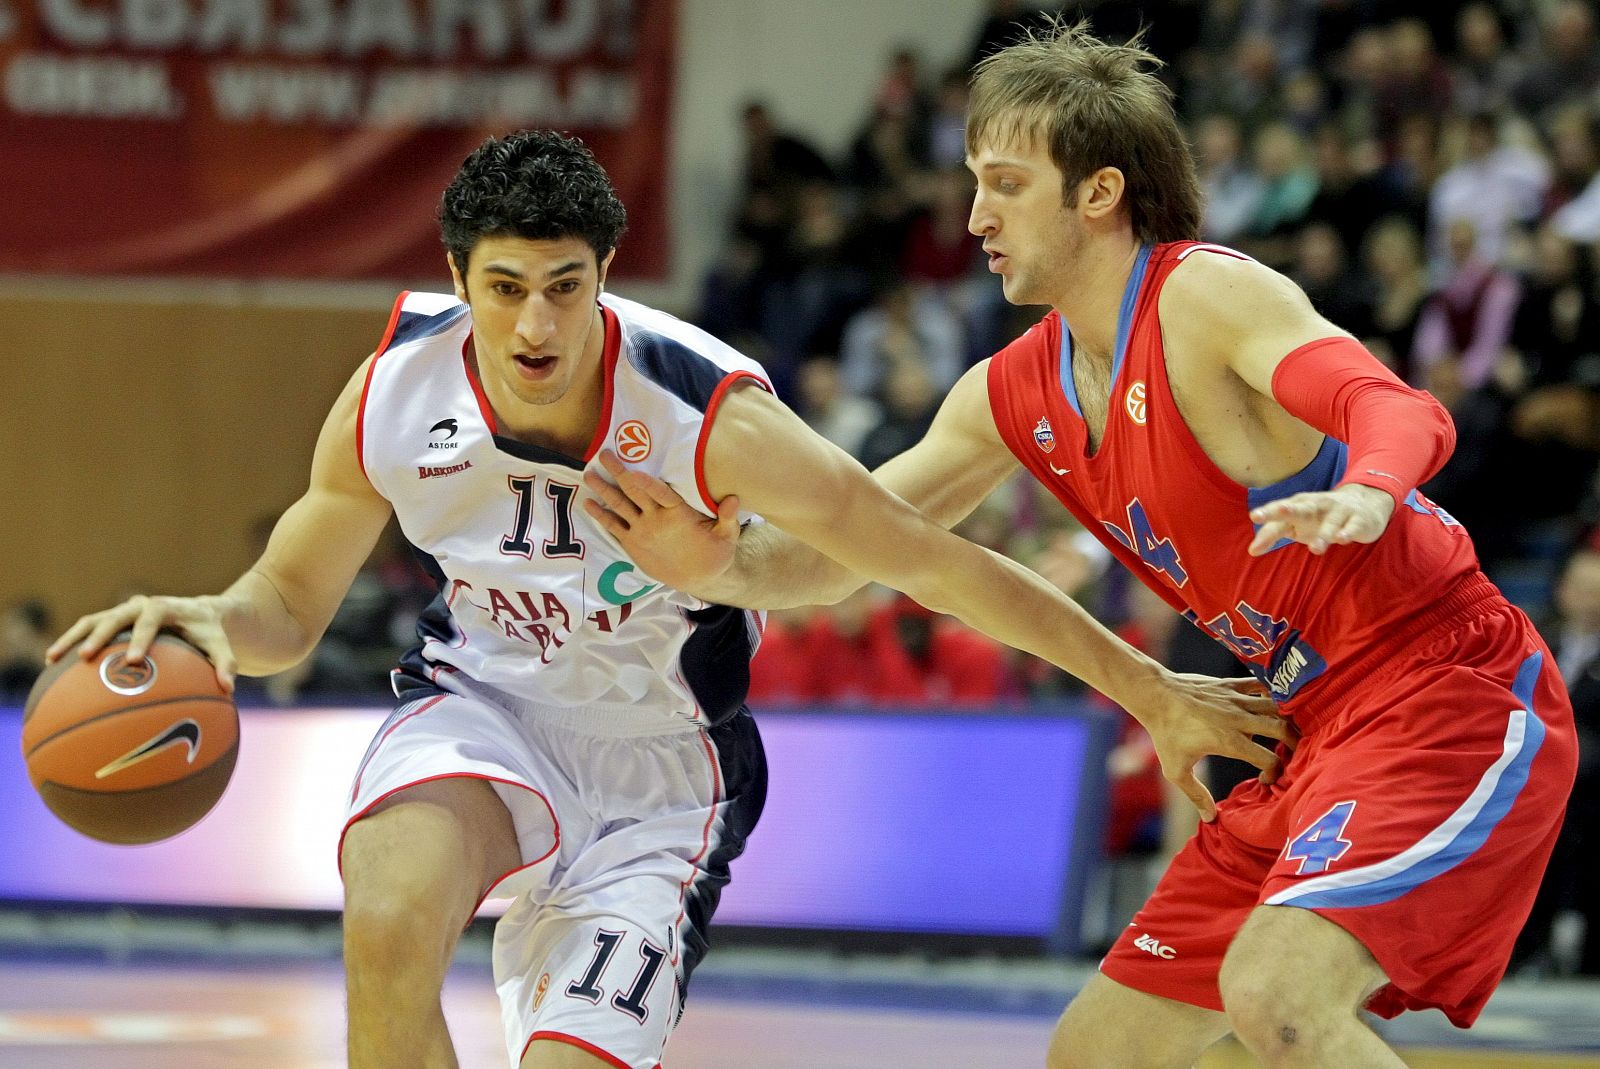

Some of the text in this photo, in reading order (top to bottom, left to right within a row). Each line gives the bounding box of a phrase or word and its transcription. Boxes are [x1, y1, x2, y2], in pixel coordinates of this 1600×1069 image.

[417, 460, 473, 479] BASKONIA
[500, 474, 586, 561] 11
[1100, 496, 1189, 589] 4
[565, 927, 667, 1026] 11
